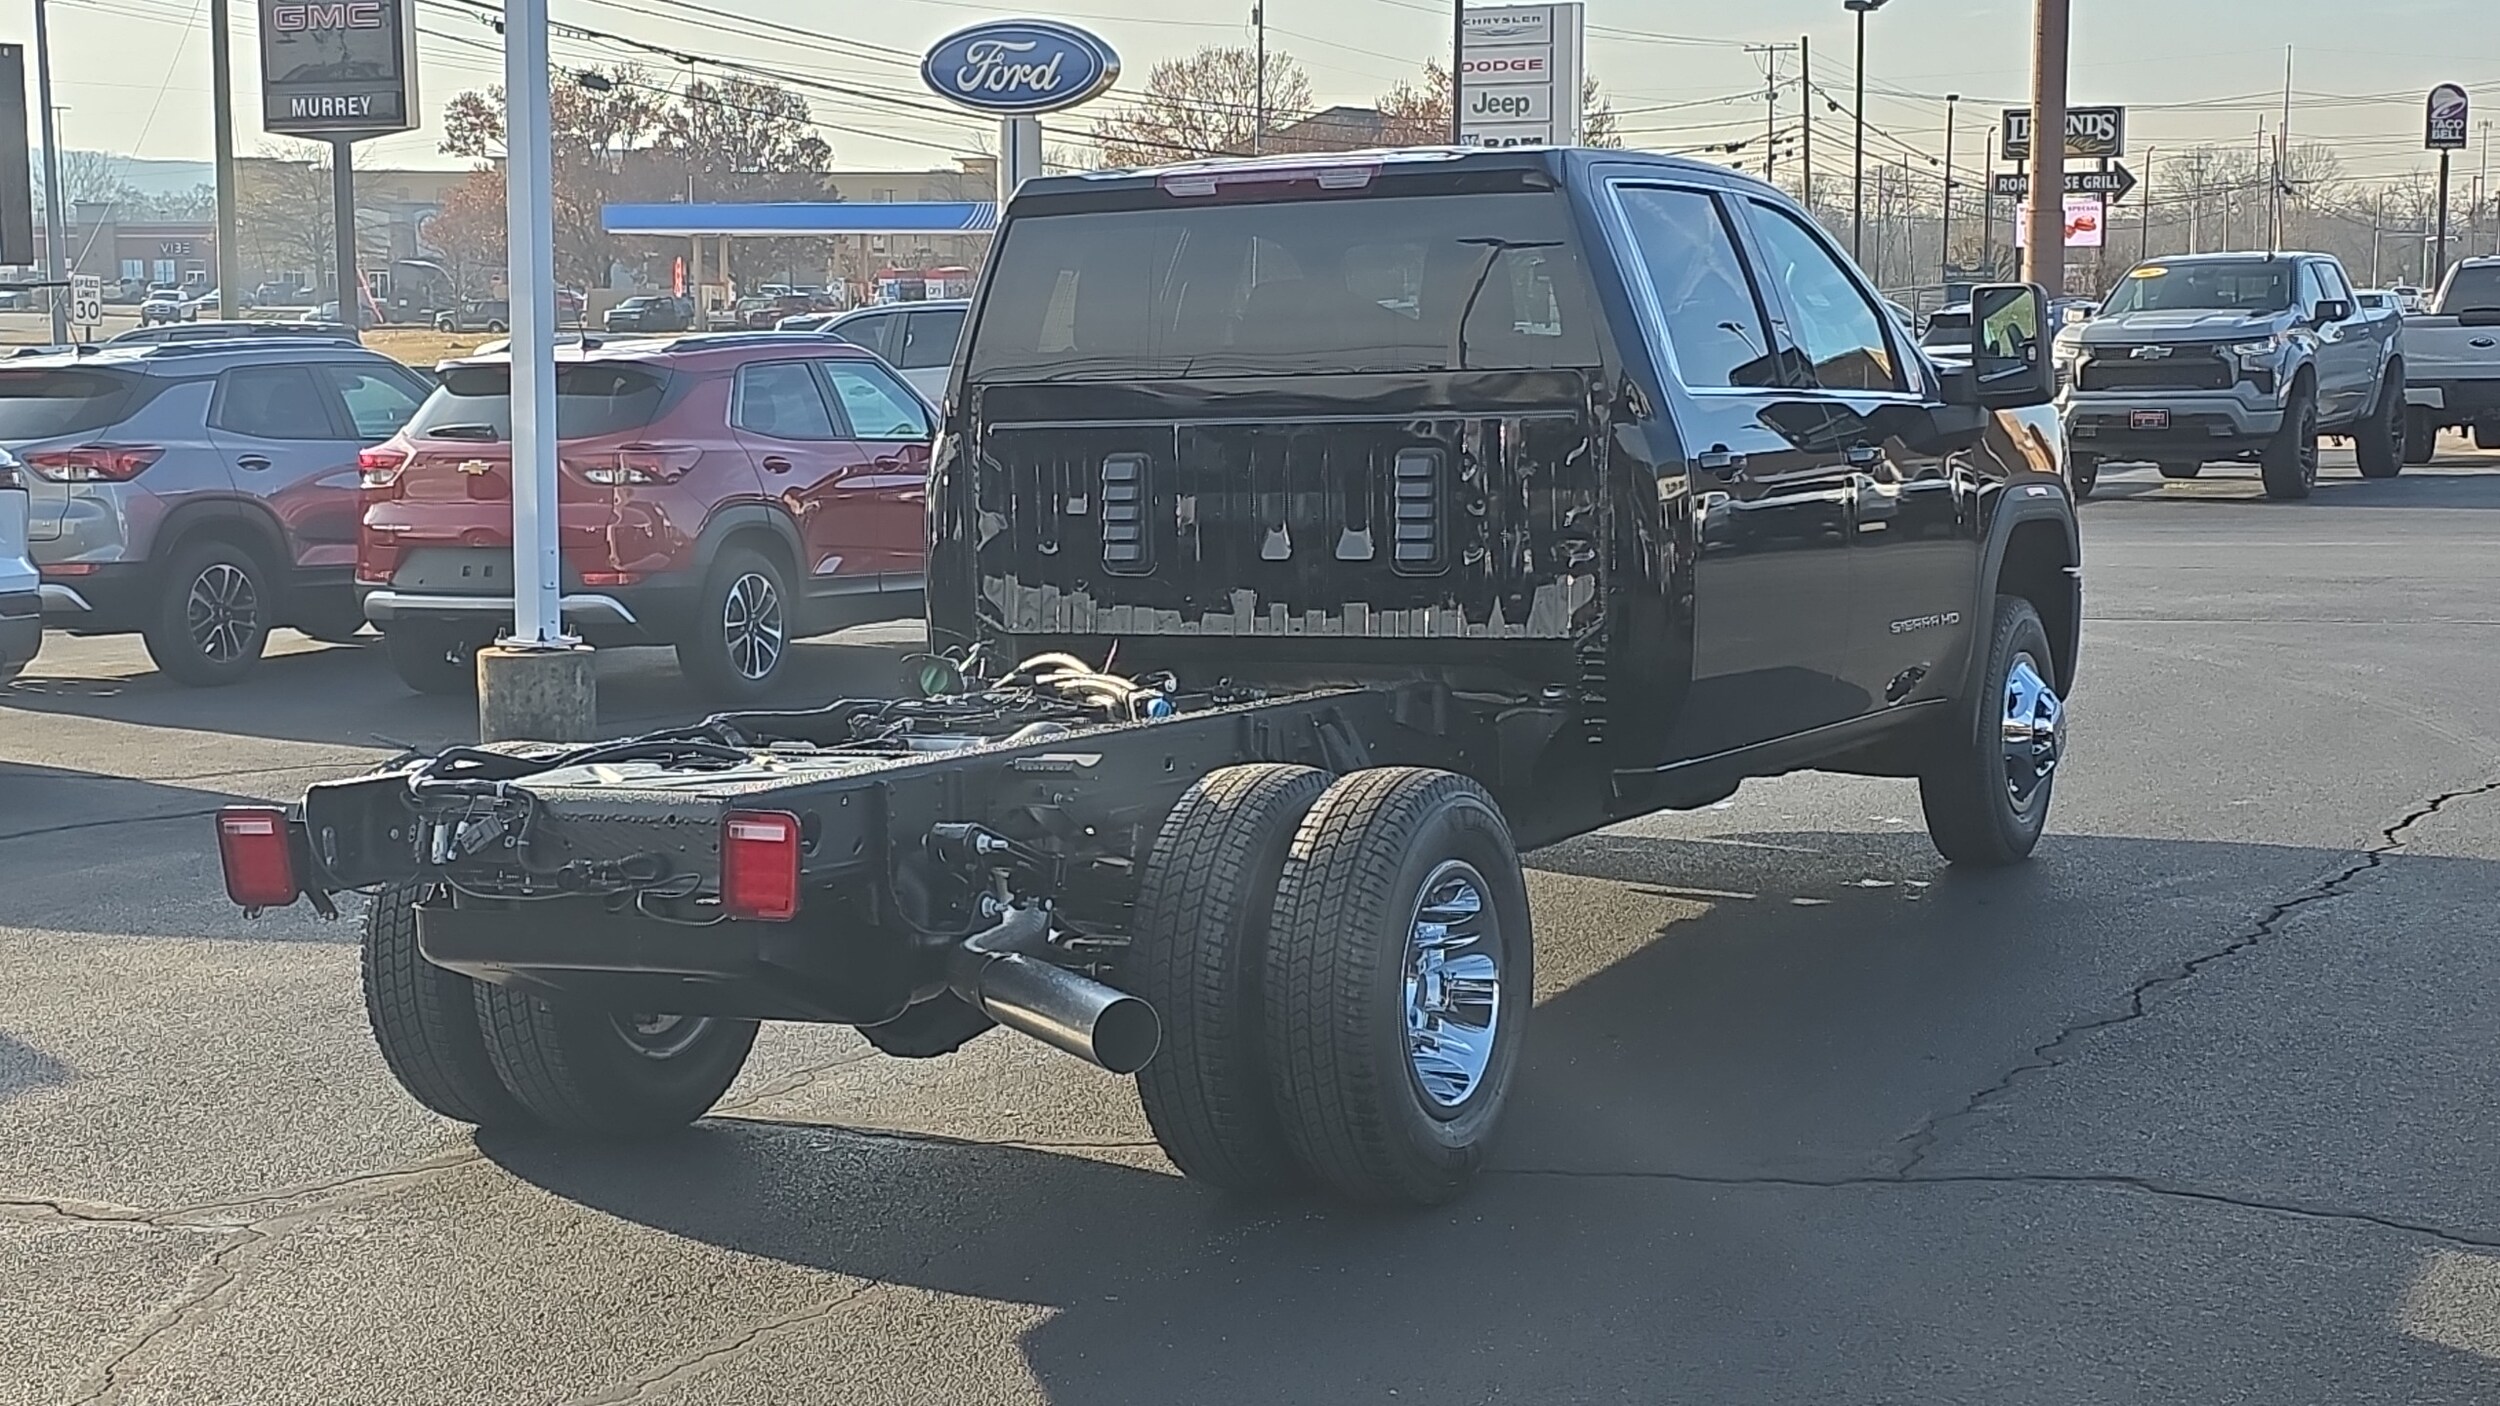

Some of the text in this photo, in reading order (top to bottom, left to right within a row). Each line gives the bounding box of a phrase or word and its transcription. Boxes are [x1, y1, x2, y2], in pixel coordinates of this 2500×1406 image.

[273, 2, 381, 31] GMC
[1462, 16, 1541, 26] CHRYSLER
[956, 40, 1065, 92] Ford
[1462, 58, 1544, 73] DODGE
[291, 95, 372, 118] MURREY
[1472, 91, 1531, 118] Jeep
[2430, 118, 2464, 130] TACO
[2431, 129, 2464, 140] BELL
[2082, 175, 2121, 190] GRILL
[74, 278, 99, 289] SPEED
[76, 289, 97, 299] LIMIT
[76, 300, 99, 320] 30
[1890, 611, 1960, 634] SIERRA HD
